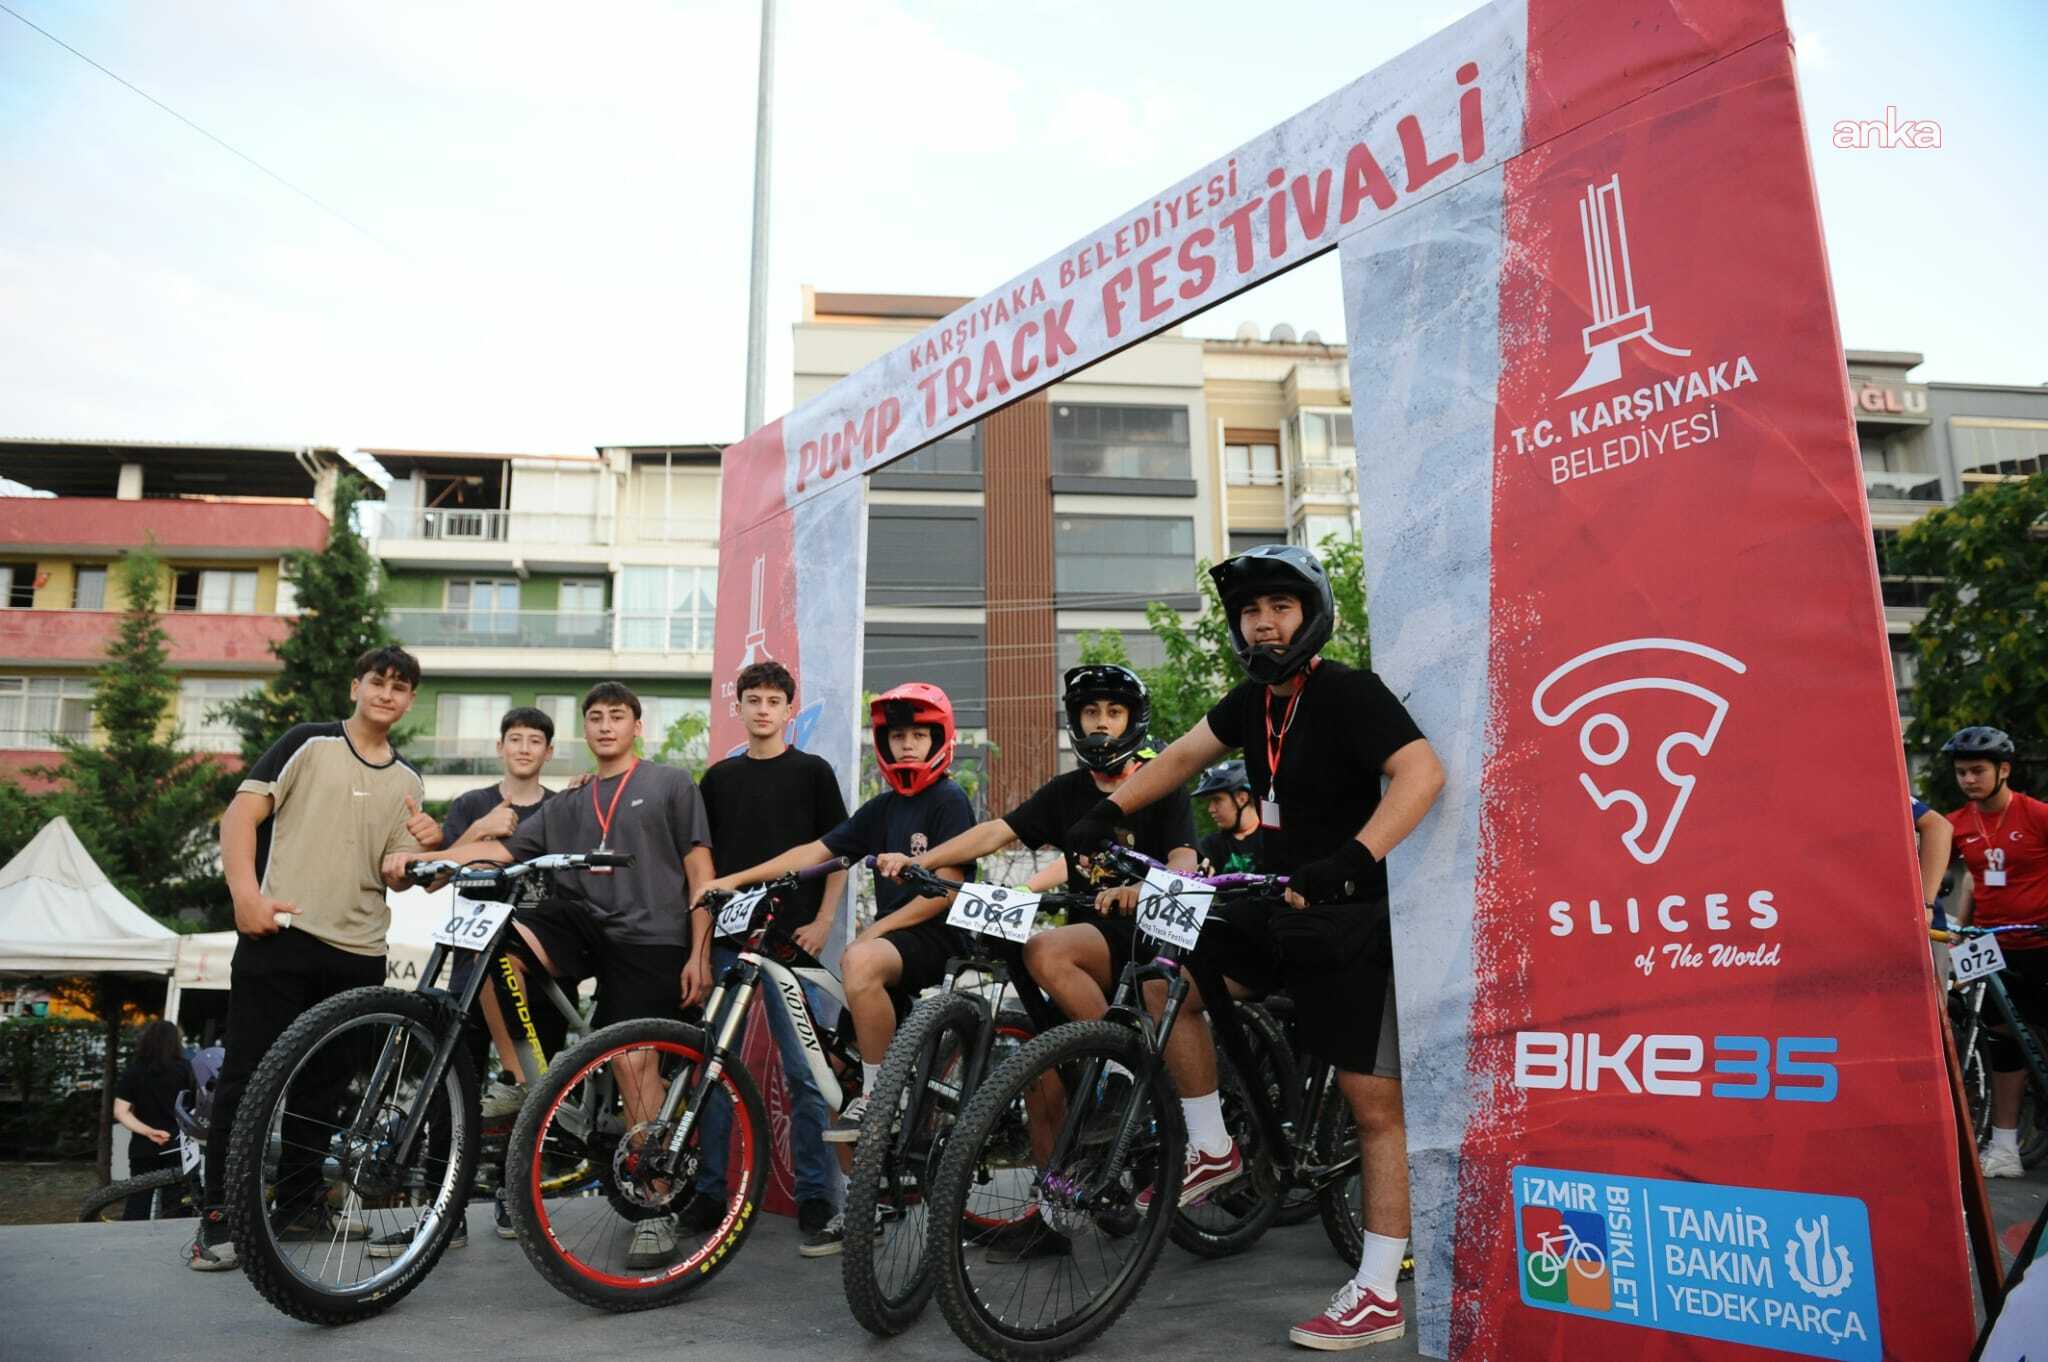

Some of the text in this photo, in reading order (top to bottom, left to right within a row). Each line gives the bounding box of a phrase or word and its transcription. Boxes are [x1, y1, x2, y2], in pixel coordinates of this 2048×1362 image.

[797, 62, 1486, 494] PUMP TRACK FESTİVALİ
[909, 157, 1239, 373] KARŞIYAKA BELEDİYESİ
[1511, 355, 1759, 456] T.C. KARŞIYAKA
[1851, 383, 1928, 414] ĞLU
[1551, 403, 1720, 486] BELEDİYESİ
[444, 916, 494, 939] 015
[721, 901, 752, 925] 034
[963, 899, 1025, 929] 064
[1146, 894, 1197, 933] 044
[1549, 890, 1779, 937] SLICES
[1633, 942, 1782, 977] of The World
[1960, 949, 1997, 973] 072
[700, 1201, 753, 1274] MAXXIS
[1659, 1204, 1771, 1250] TAMİR
[1665, 1244, 1776, 1289] BAKIM
[1666, 1284, 1868, 1346] YEDEK PARÇA
